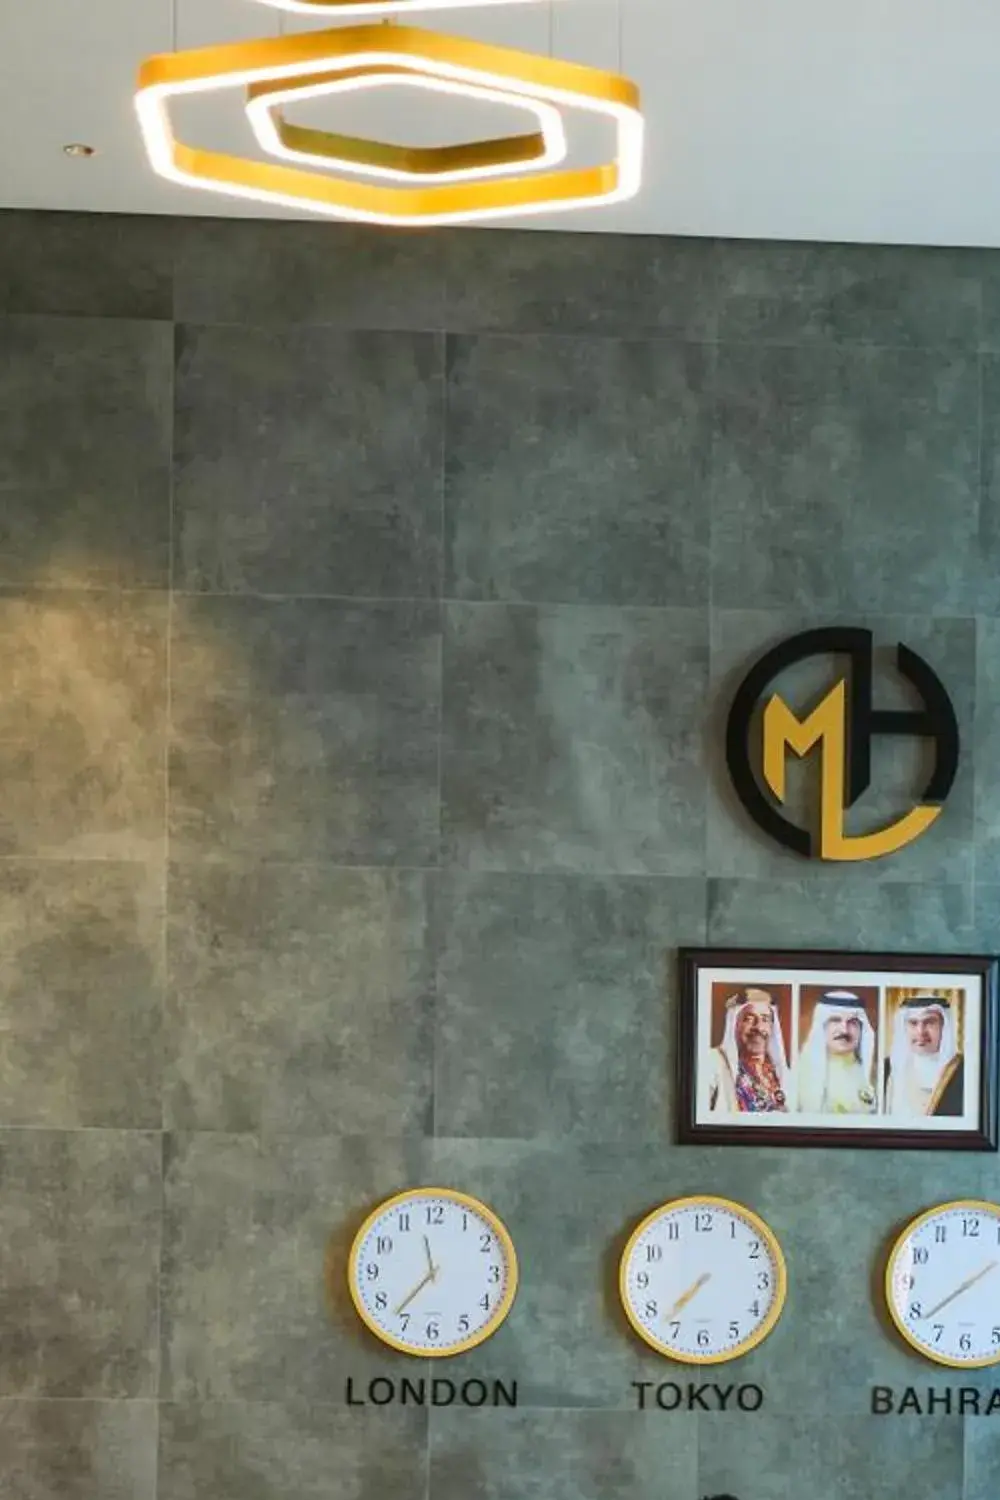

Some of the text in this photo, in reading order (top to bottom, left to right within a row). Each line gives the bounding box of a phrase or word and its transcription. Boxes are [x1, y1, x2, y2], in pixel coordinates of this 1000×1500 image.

[398, 1213, 410, 1232] 11
[426, 1205, 445, 1225] 12
[694, 1213, 713, 1233] 12
[668, 1221, 680, 1241] 11
[935, 1225, 947, 1244] 11
[962, 1217, 980, 1238] 12
[376, 1235, 393, 1255] 10
[479, 1233, 492, 1253] 2
[748, 1241, 761, 1260] 2
[646, 1244, 663, 1263] 10
[913, 1247, 929, 1265] 10
[366, 1263, 379, 1281] 9
[487, 1265, 500, 1284] 3
[636, 1272, 650, 1290] 9
[757, 1271, 770, 1291] 3
[375, 1291, 388, 1309] 8
[476, 1293, 490, 1311] 4
[645, 1300, 658, 1319] 8
[747, 1299, 760, 1318] 4
[909, 1302, 922, 1321] 8
[399, 1313, 411, 1332] 7
[425, 1322, 440, 1340] 6
[457, 1313, 470, 1332] 5
[669, 1320, 682, 1340] 7
[728, 1320, 740, 1339] 5
[696, 1330, 709, 1347] 6
[933, 1324, 945, 1343] 7
[959, 1333, 972, 1351] 6
[346, 1377, 518, 1408] LONDON
[631, 1381, 764, 1412] TOKYO
